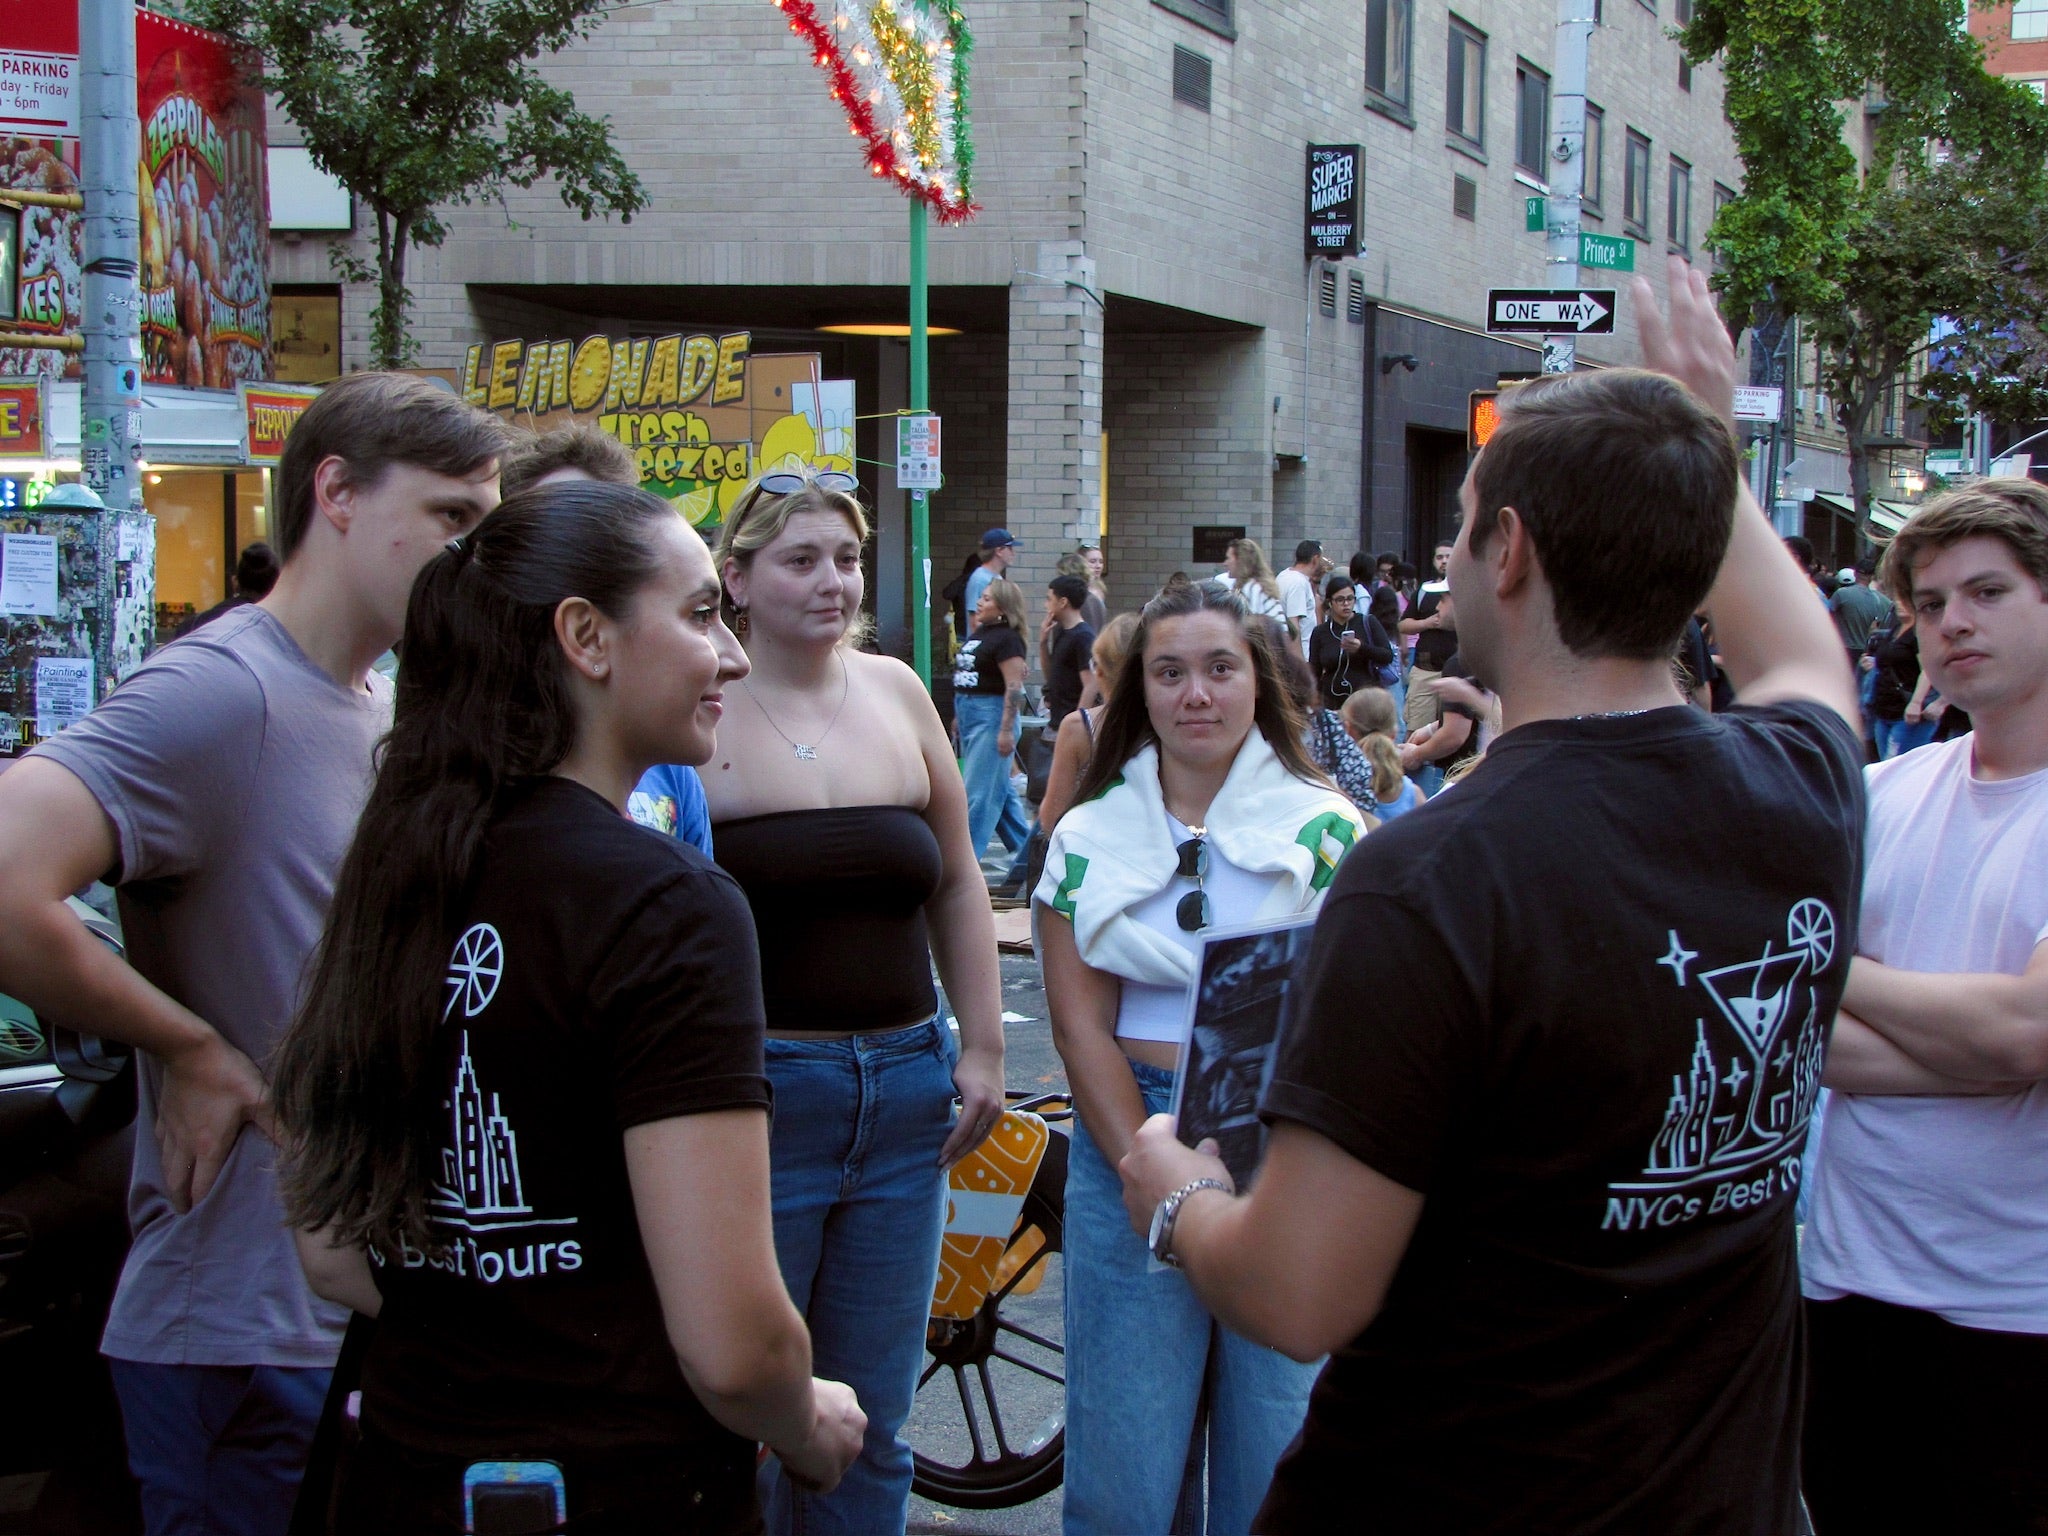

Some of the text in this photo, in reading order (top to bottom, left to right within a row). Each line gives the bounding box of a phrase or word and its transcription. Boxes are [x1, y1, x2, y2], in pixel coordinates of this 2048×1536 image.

[2, 60, 69, 79] PARKING
[34, 82, 69, 99] Friday
[15, 97, 40, 110] 6pm
[147, 96, 224, 184] ZEPPOLES
[1312, 155, 1354, 192] SUPER
[1311, 179, 1354, 213] MARKET
[1327, 212, 1336, 220] ON
[1528, 200, 1537, 215] St
[1311, 224, 1352, 236] MULBERRY
[1317, 236, 1346, 247] STREET
[1584, 237, 1627, 265] Prince St
[1505, 303, 1596, 320] ONE WAY
[462, 331, 751, 416] LEMONADE
[1744, 390, 1770, 398] PARKING
[253, 406, 304, 441] ZEPPOL
[43, 667, 83, 678] Painting
[1601, 1193, 1700, 1230] NYCs
[1708, 1168, 1772, 1215] Best
